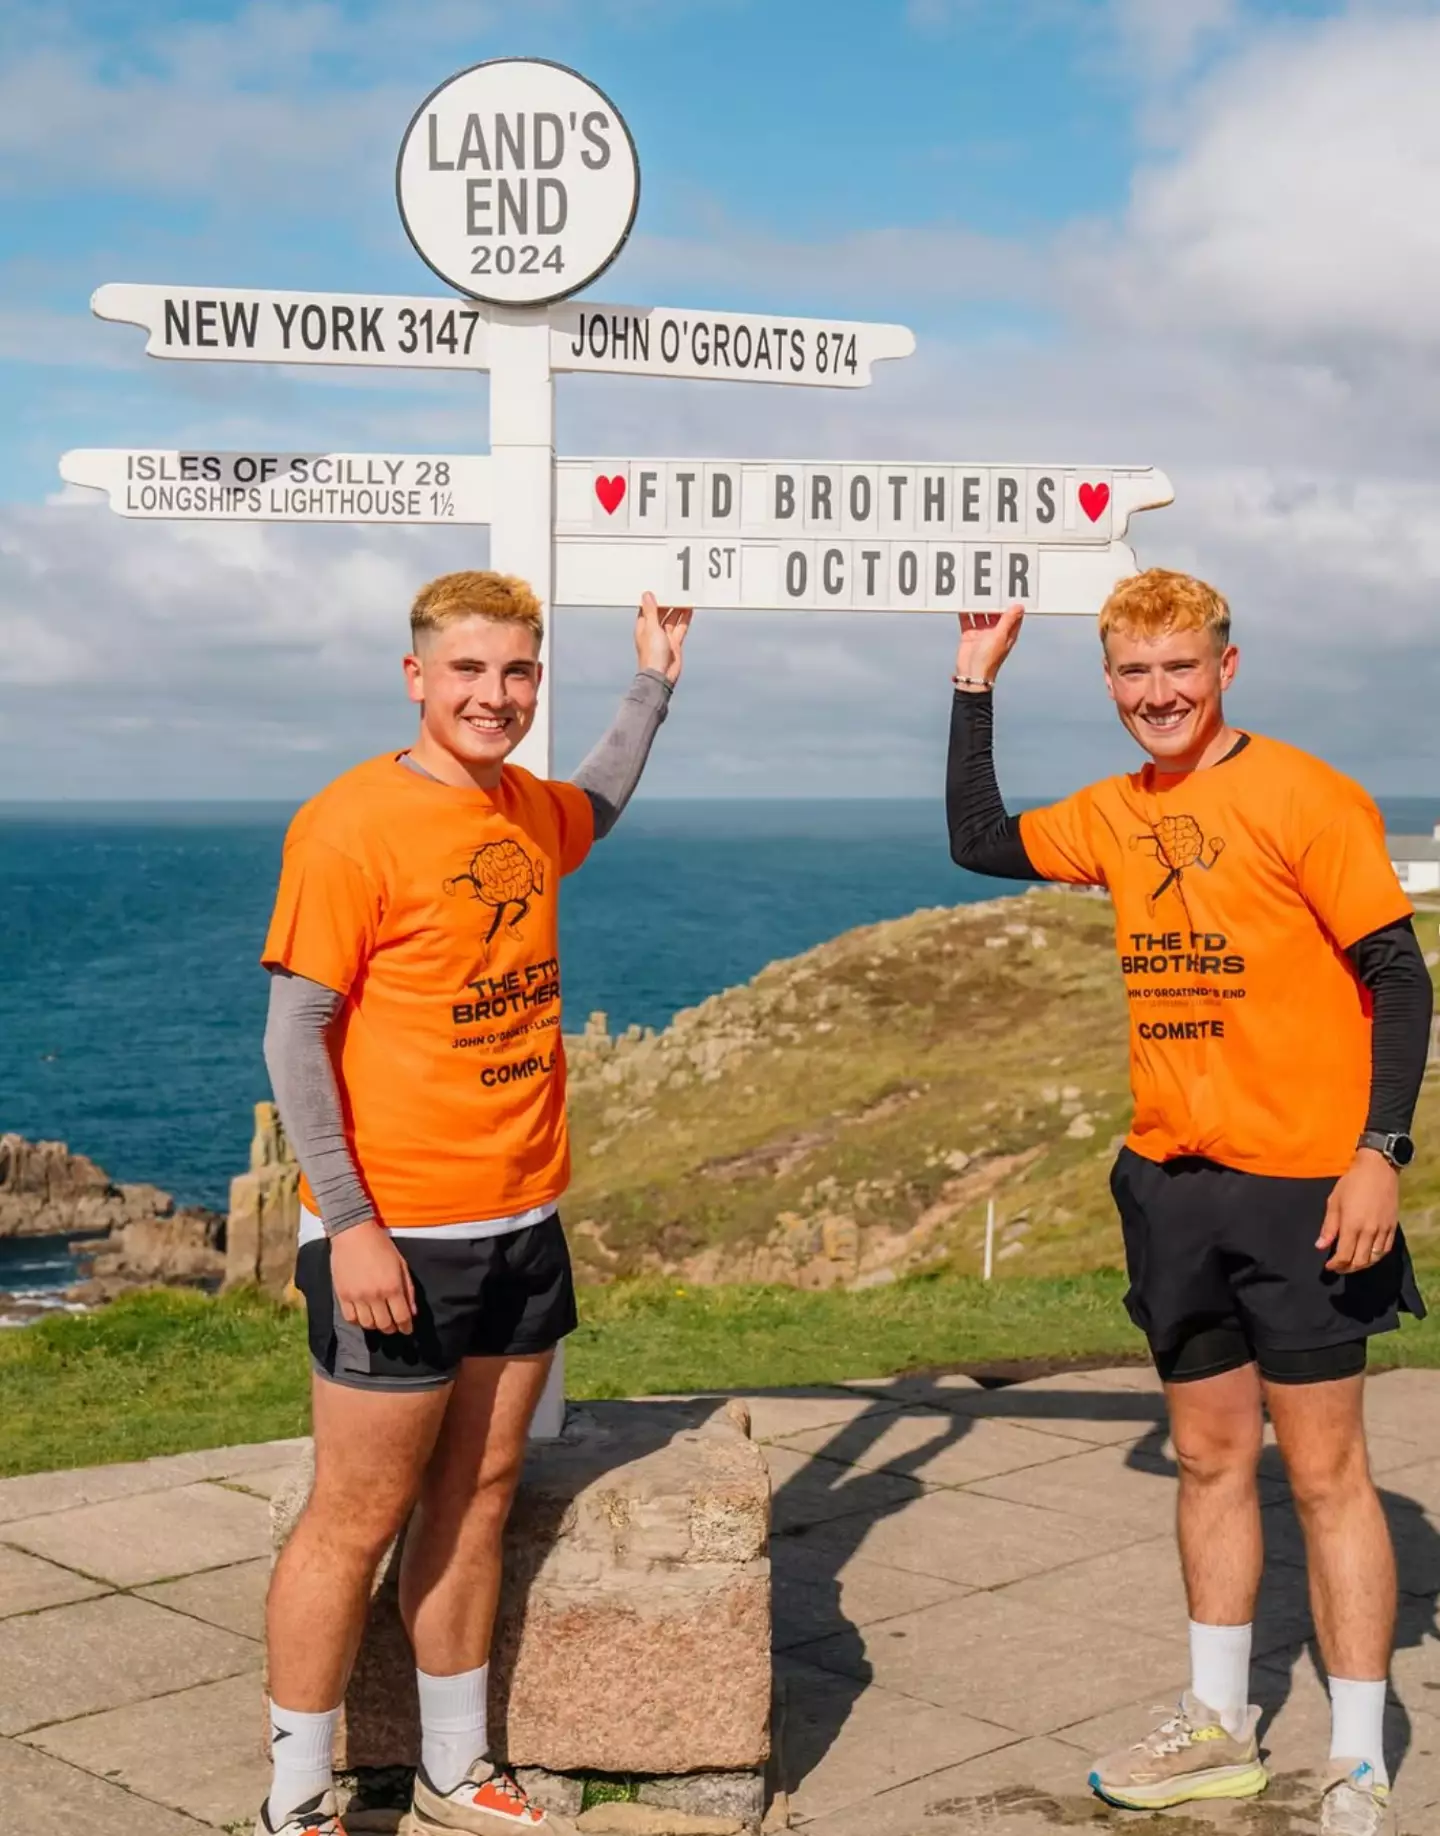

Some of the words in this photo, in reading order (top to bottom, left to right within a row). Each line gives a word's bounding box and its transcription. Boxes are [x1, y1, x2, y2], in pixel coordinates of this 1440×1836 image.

[428, 111, 611, 171] LAND'S
[466, 178, 568, 236] END
[470, 245, 565, 275] 2024
[164, 299, 260, 348] NEW
[272, 303, 386, 353] YORK
[397, 307, 480, 355] 3147
[571, 313, 650, 361] JOHN
[660, 319, 805, 372] O'GROATS
[815, 331, 858, 375] 874
[126, 455, 222, 483] ISLES
[233, 456, 278, 484] OF
[288, 458, 405, 486] SCILLY
[414, 461, 451, 487] 28
[126, 485, 262, 513] LONGSHIPS
[270, 488, 422, 516] LIGHTHOUSE
[638, 471, 734, 518] FTD
[774, 473, 1057, 525] BROTHERS
[785, 547, 1031, 599] OCTOBER
[1130, 931, 1182, 951] THE
[467, 970, 520, 998] THE
[524, 957, 560, 985] FTD
[451, 1035, 485, 1049] JOHN
